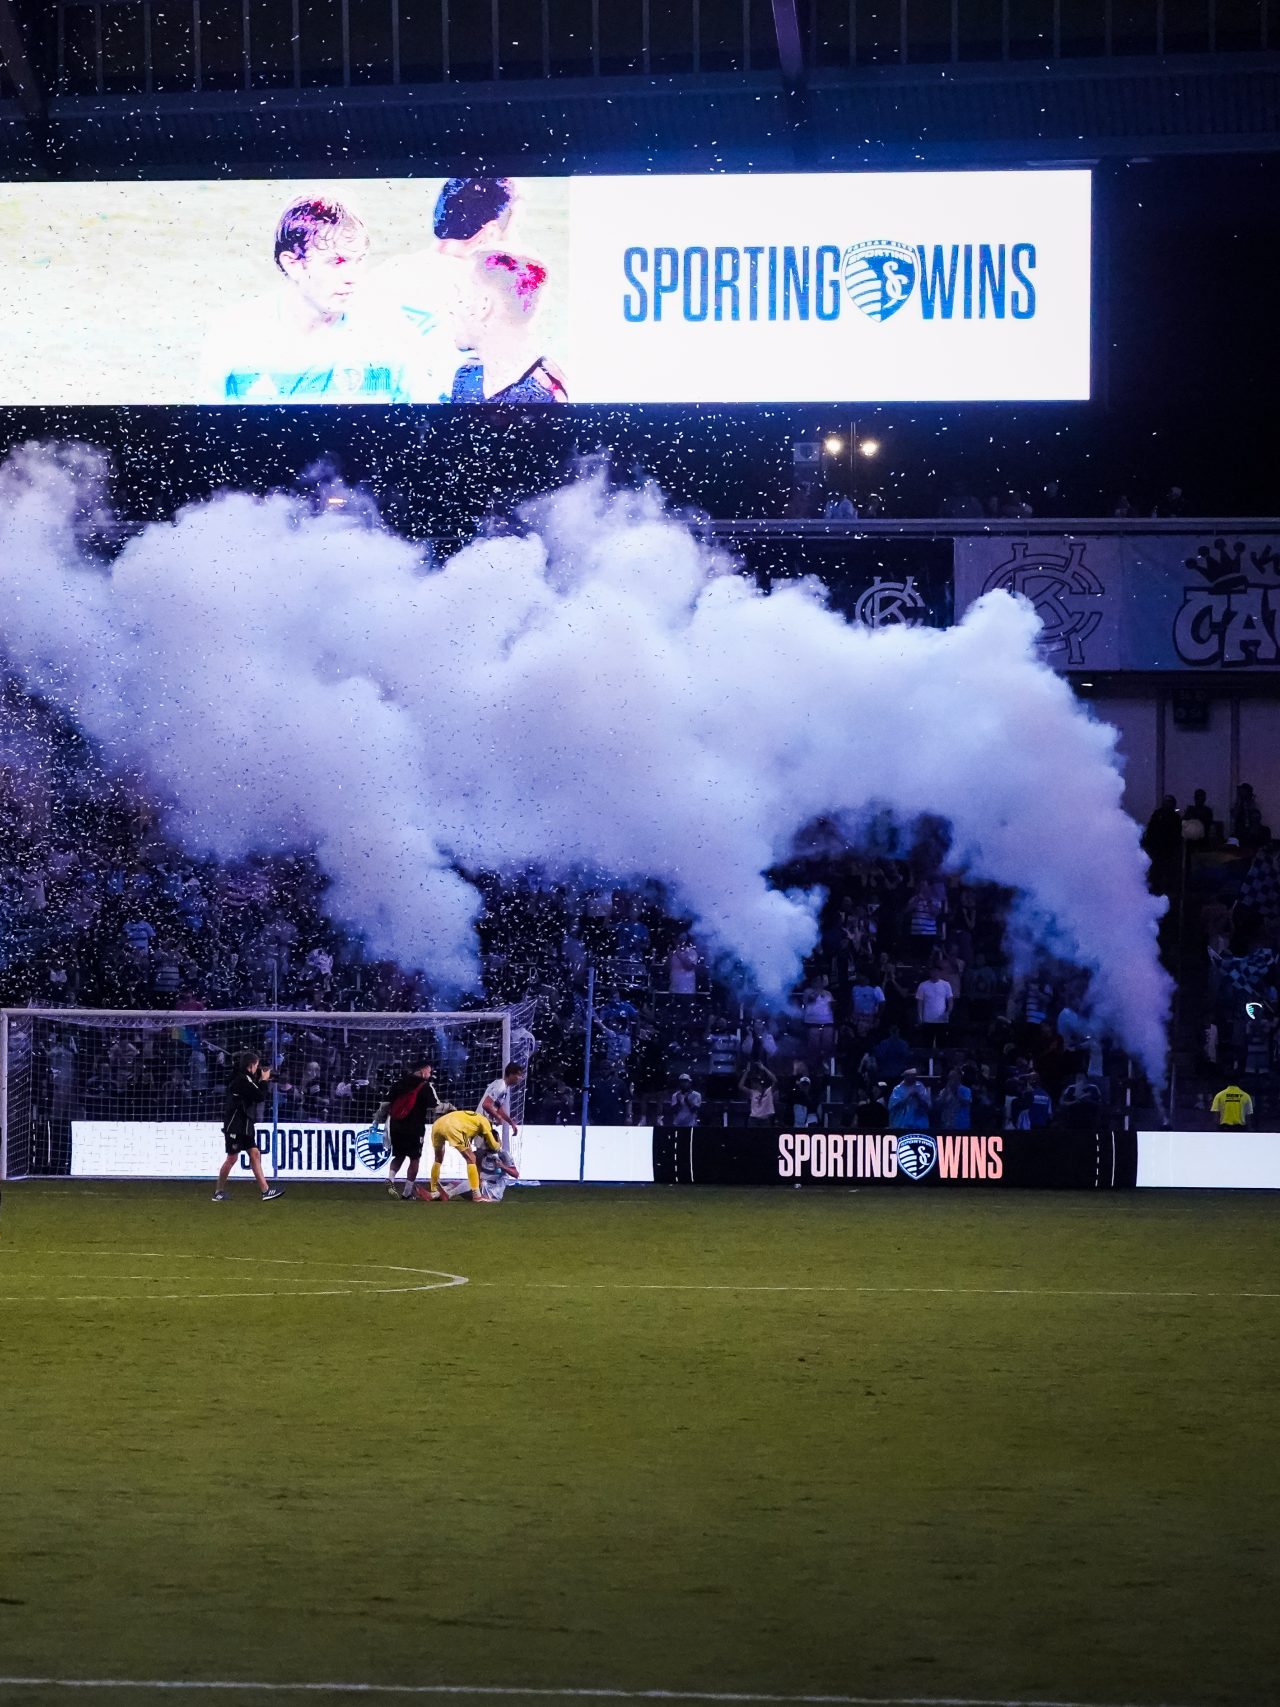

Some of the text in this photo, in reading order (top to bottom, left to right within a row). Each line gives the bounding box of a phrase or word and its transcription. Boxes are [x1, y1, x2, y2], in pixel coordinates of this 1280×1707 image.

[623, 243, 1037, 322] SPORTING WINS
[1173, 586, 1280, 667] CA
[778, 1133, 1003, 1179] SPORTING WINS
